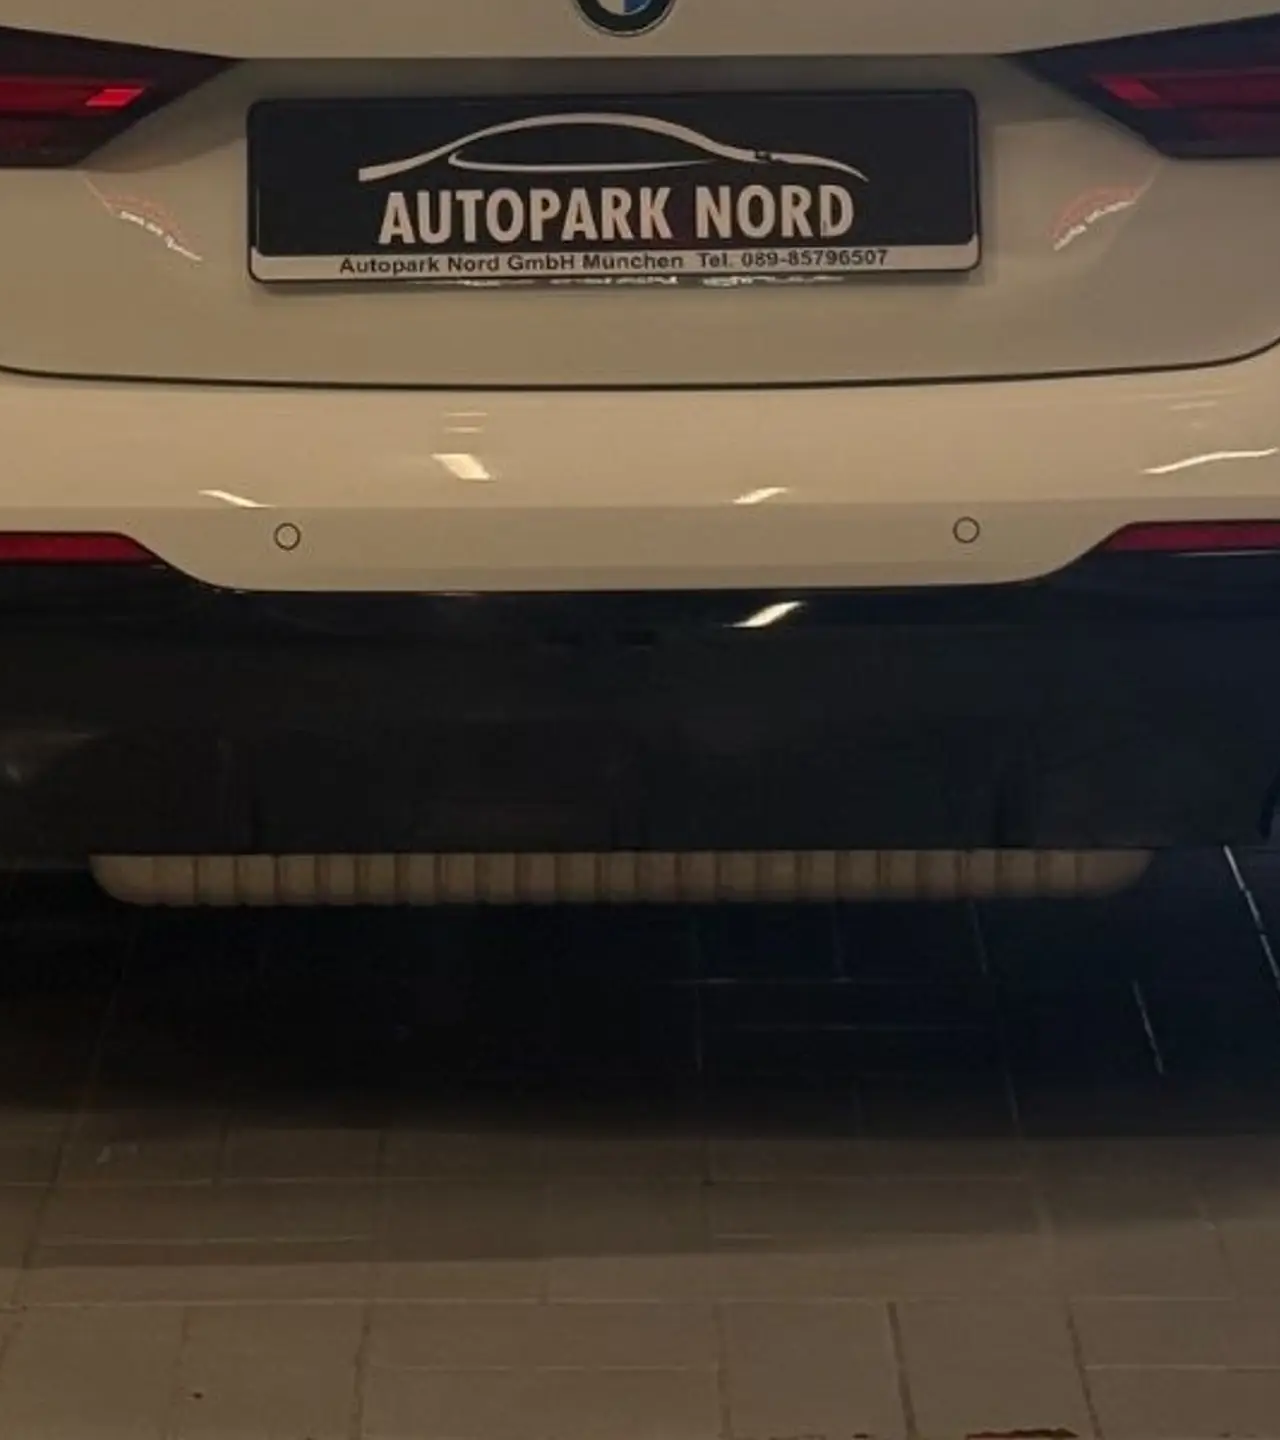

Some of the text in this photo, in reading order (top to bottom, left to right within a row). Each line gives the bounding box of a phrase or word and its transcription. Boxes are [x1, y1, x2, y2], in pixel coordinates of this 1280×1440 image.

[378, 184, 854, 245] AUTOPARK NORD
[339, 248, 889, 276] Autopark Nord GmbH München Tel. 089-85796507
